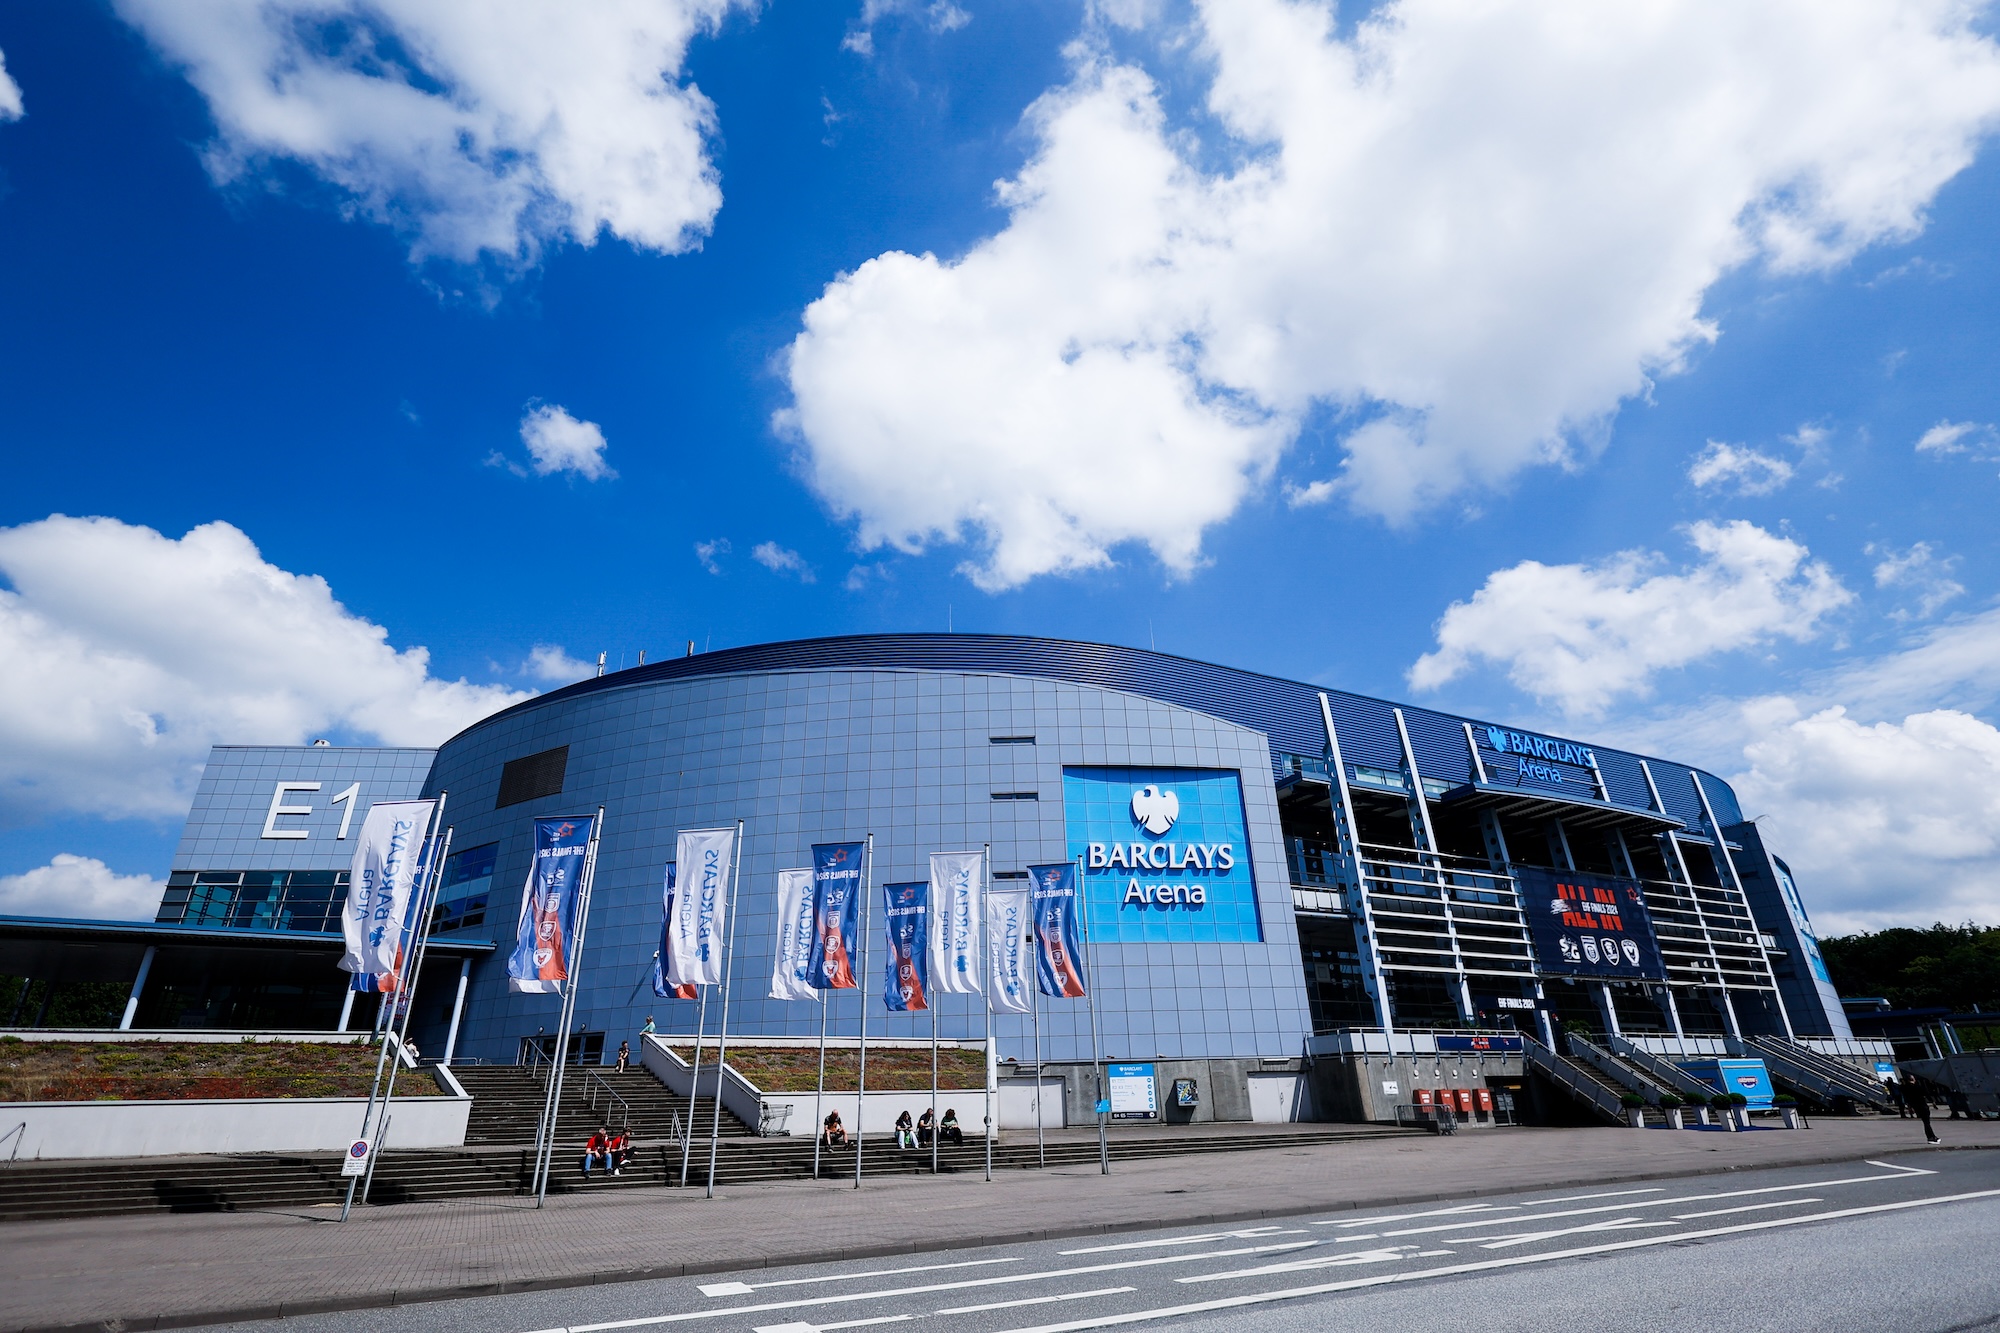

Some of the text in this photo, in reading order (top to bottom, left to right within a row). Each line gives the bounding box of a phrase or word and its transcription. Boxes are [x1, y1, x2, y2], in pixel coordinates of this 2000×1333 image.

[1509, 732, 1594, 767] BARCLAYS
[1519, 757, 1562, 783] Arena
[261, 782, 360, 840] E1
[1089, 842, 1234, 869] BARCLAYS
[1124, 878, 1206, 903] Arena
